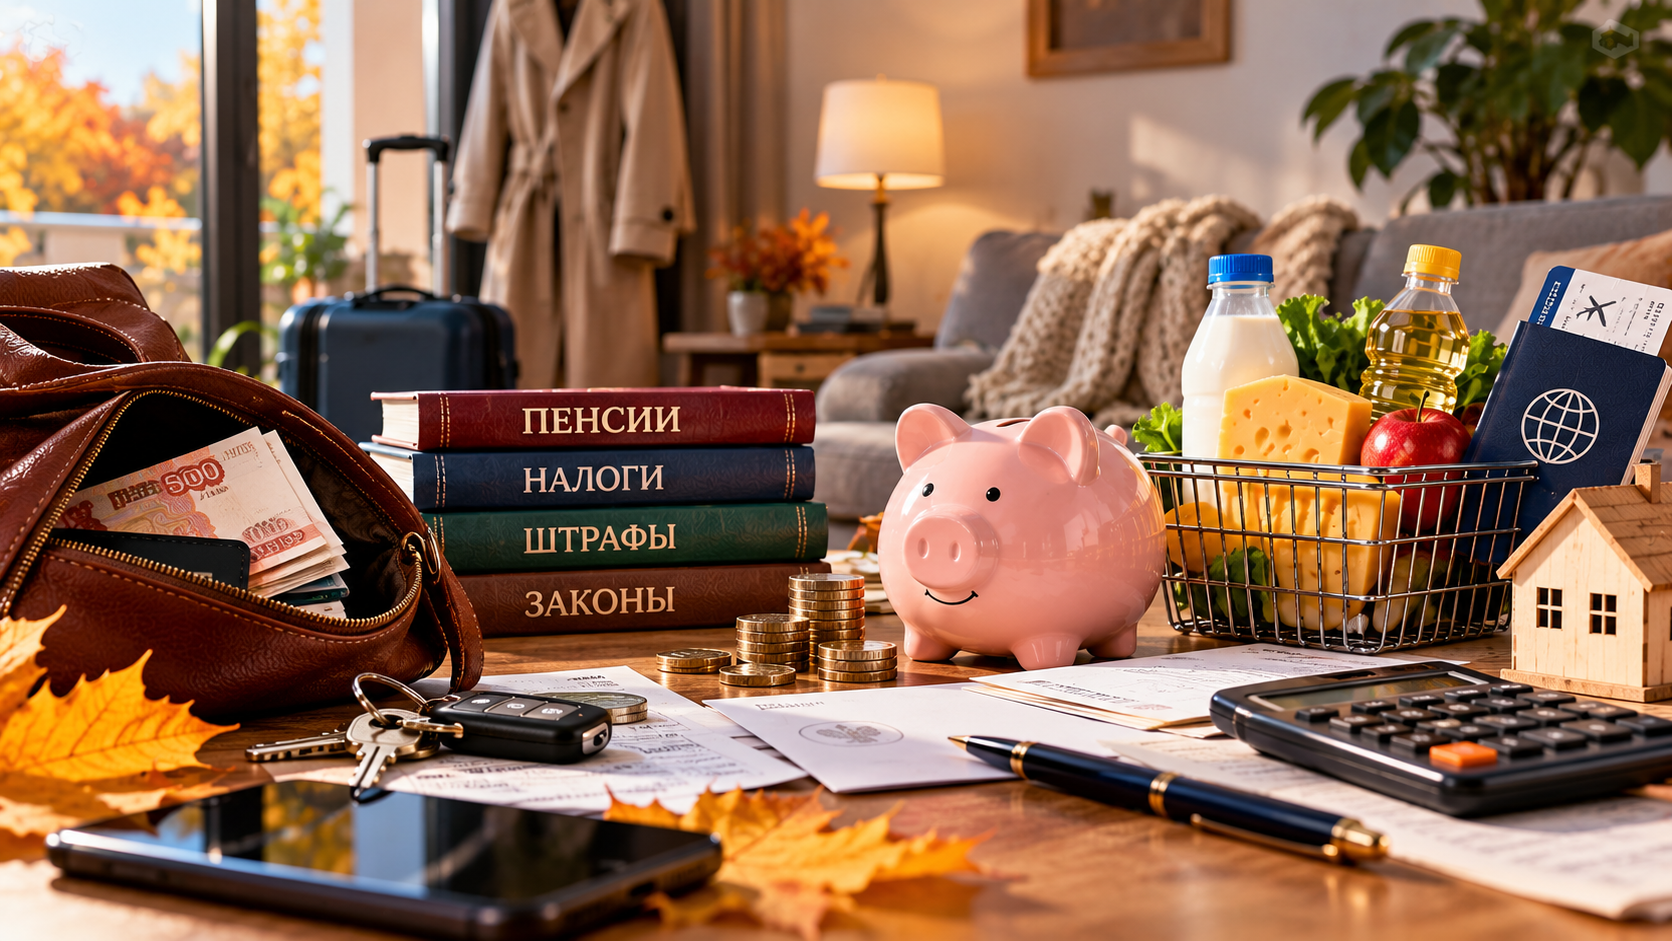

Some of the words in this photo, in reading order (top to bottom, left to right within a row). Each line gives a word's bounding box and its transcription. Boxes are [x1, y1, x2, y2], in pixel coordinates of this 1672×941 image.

[521, 406, 681, 435] ПЕНСИИ
[163, 461, 221, 494] 500
[523, 464, 664, 494] НАЛОГИ
[523, 523, 676, 554] ШТРАФЫ
[525, 586, 676, 617] ЗАКОНЫ
